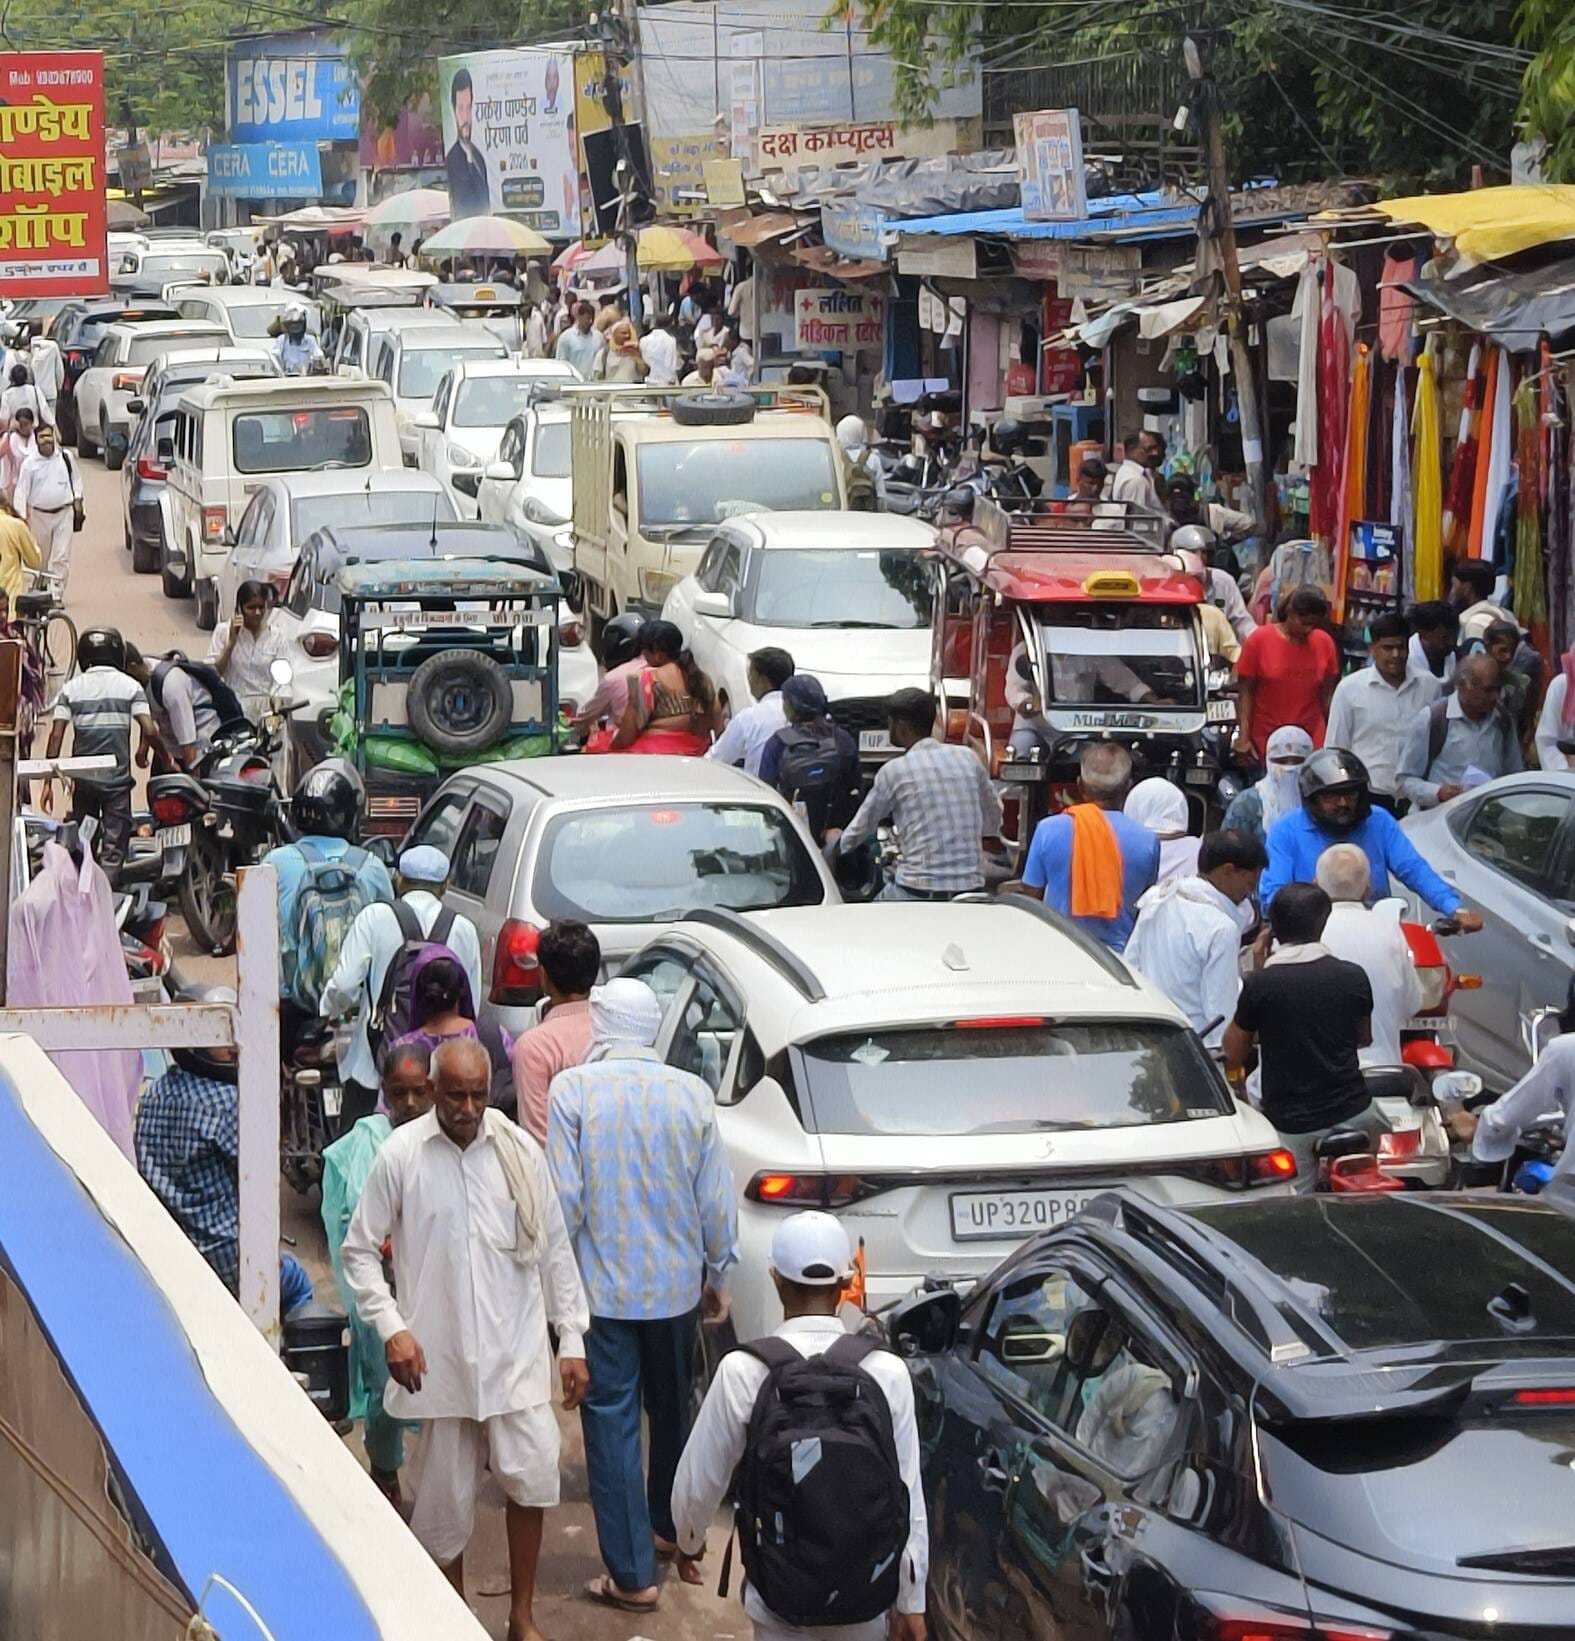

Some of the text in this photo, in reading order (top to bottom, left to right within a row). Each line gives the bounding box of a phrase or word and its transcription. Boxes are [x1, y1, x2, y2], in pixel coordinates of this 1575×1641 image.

[237, 60, 321, 124] ESSEL
[505, 91, 536, 118] पाण्डेय
[761, 132, 798, 157] दक्ष
[214, 151, 310, 176] CERA CERA
